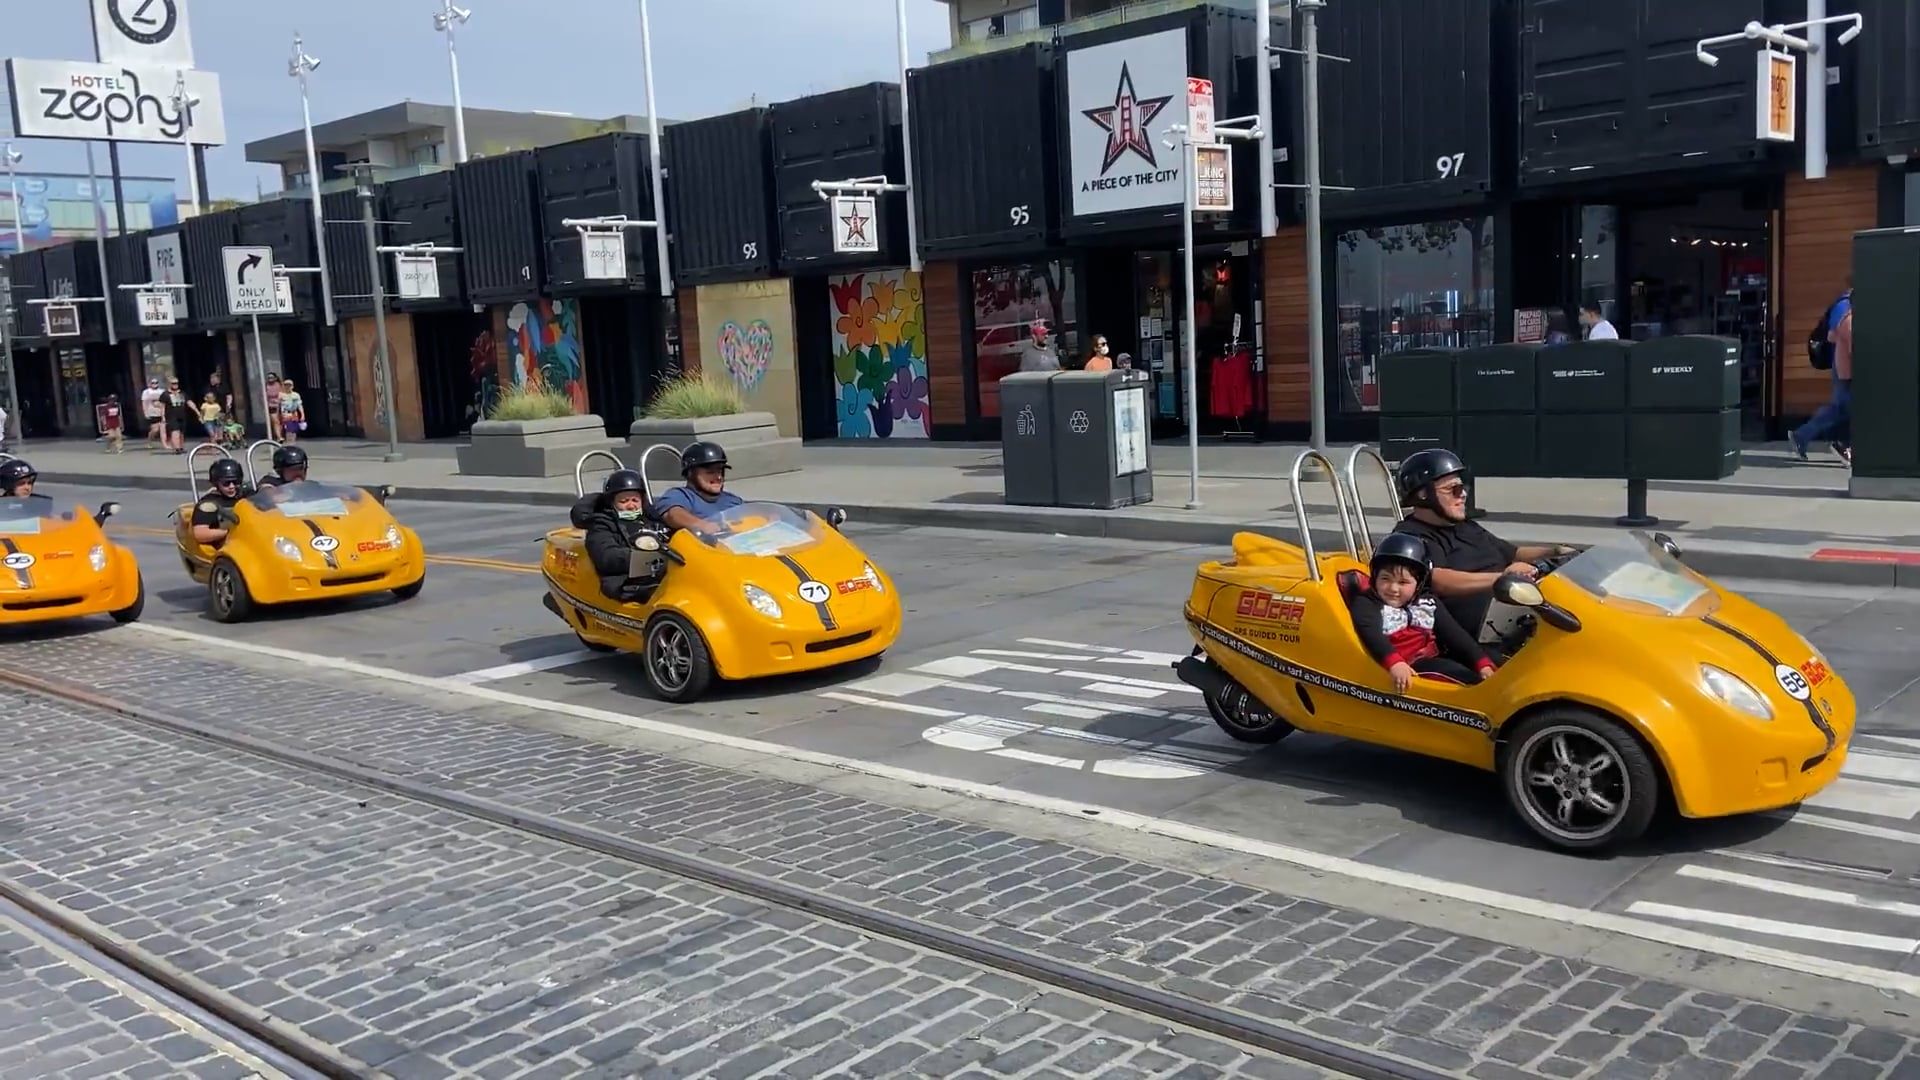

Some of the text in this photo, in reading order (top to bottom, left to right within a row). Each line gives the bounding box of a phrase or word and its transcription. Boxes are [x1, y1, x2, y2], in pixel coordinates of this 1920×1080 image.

[71, 75, 125, 90] HOTEL
[1436, 152, 1465, 179] 97
[1081, 169, 1178, 192] A PIECE OF THE CITY
[1010, 205, 1030, 226] 95
[238, 287, 266, 297] ONLY
[236, 299, 272, 310] AHEAD
[1663, 365, 1694, 373] WEEKLY
[314, 538, 333, 547] 47
[803, 585, 827, 598] 71
[1248, 629, 1277, 640] GUIDED
[1781, 671, 1808, 694] 58
[1321, 677, 1349, 693] Union
[1349, 686, 1384, 705] Square
[1392, 699, 1491, 730] www.GoCarTours.co
